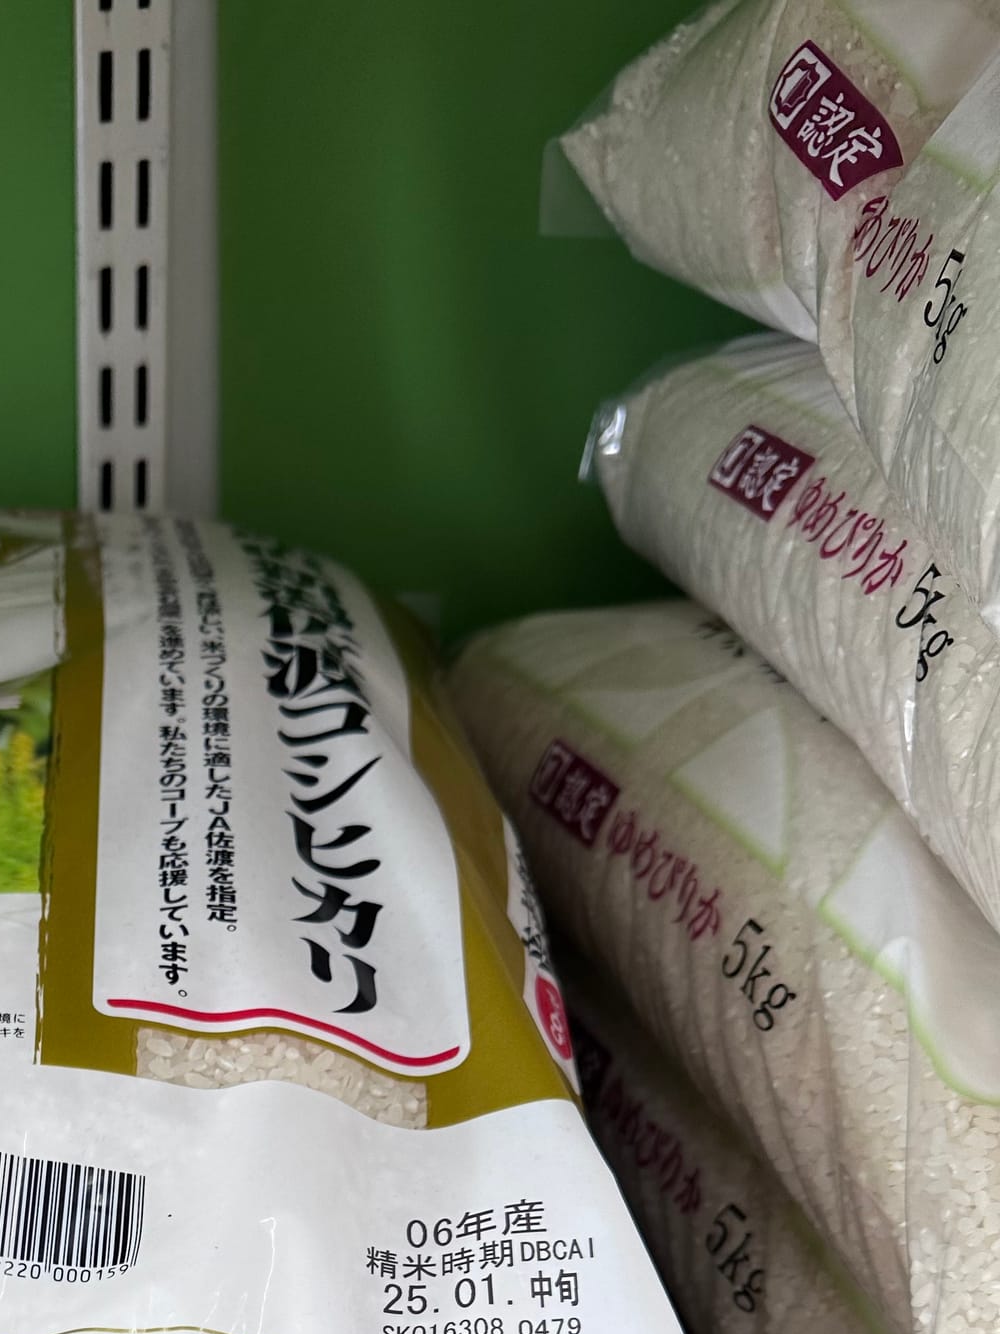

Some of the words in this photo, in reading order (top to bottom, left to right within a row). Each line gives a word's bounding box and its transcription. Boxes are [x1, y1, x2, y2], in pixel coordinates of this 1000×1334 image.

[721, 918, 797, 1032] 5kg
[406, 1198, 548, 1248] 06年産
[52, 1262, 130, 1284] 000159
[365, 1238, 514, 1281] 精米時期
[706, 1203, 766, 1314] 5kg
